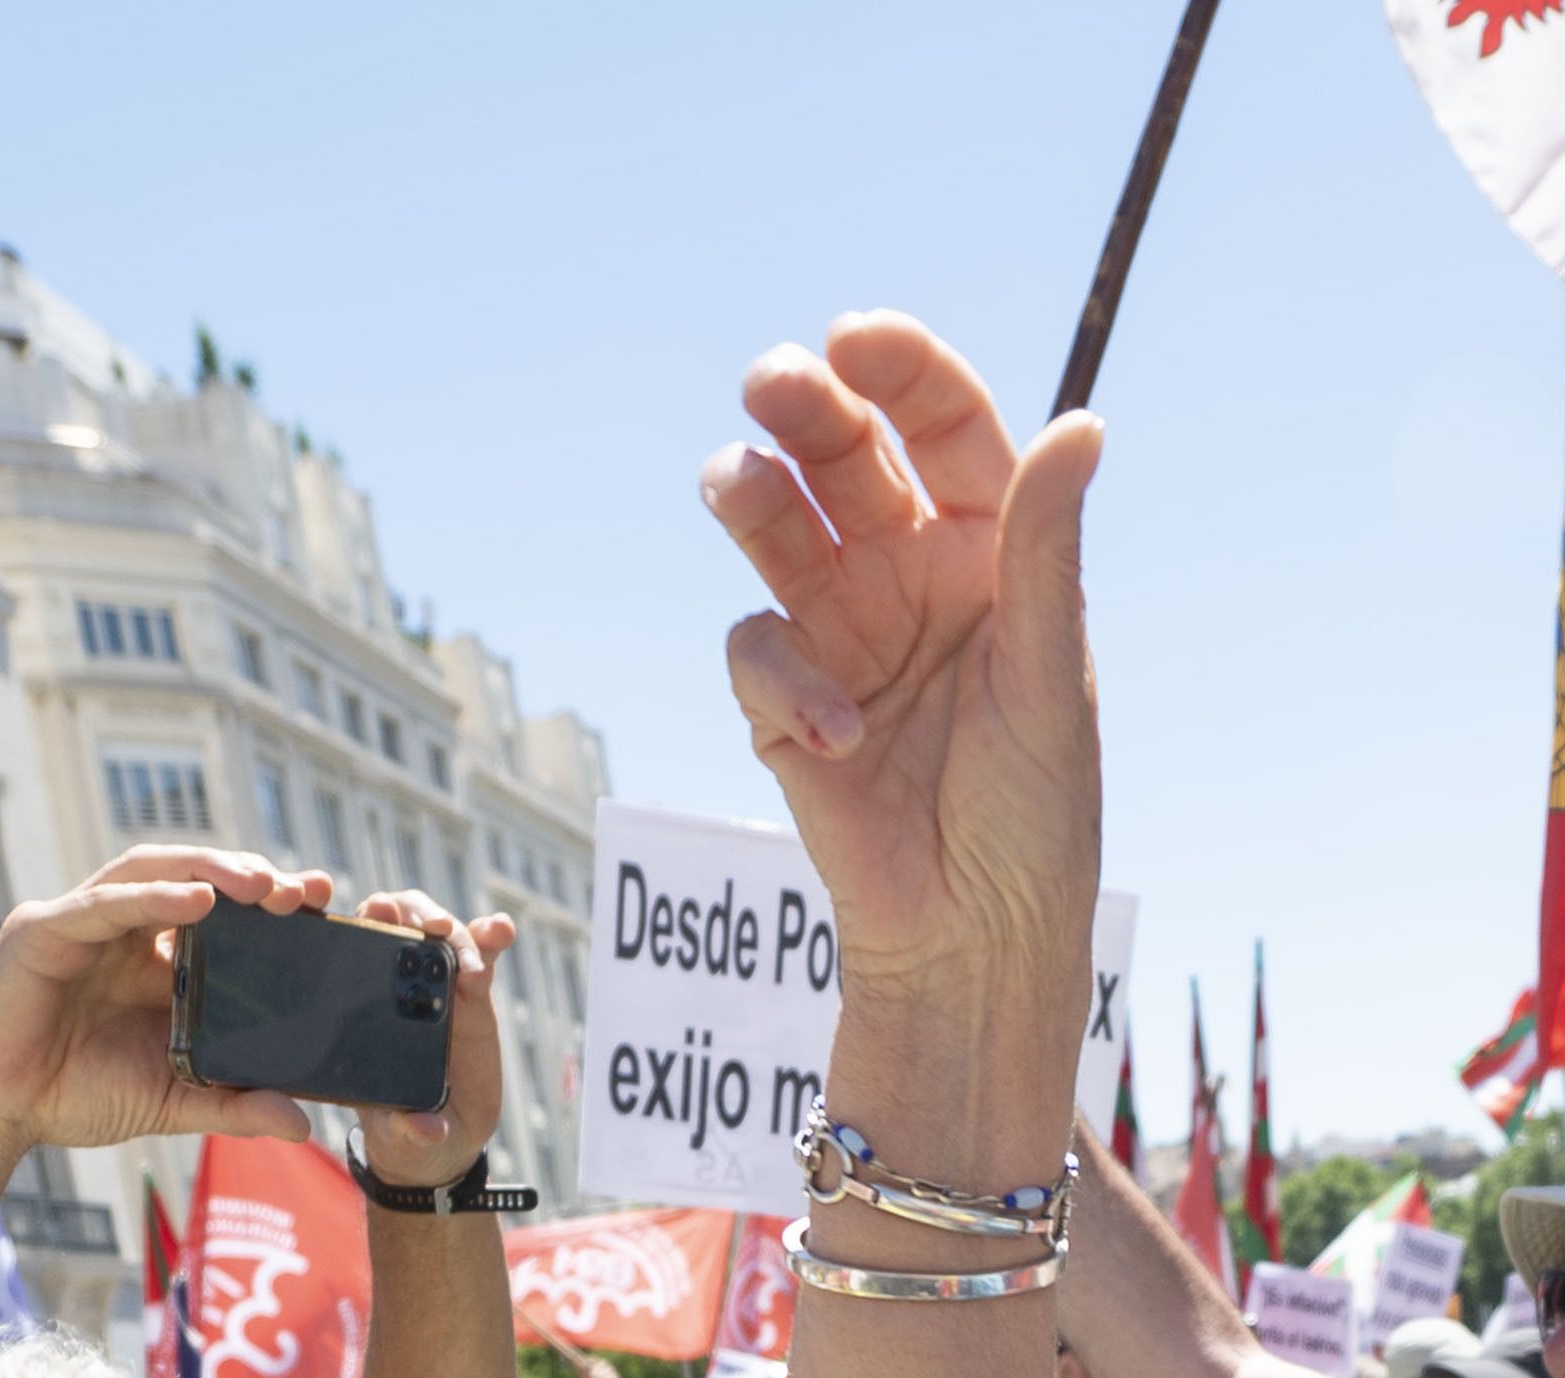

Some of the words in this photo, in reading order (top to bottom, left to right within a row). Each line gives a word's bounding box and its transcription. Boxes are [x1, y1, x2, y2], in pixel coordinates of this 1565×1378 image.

[615, 861, 759, 980] Desde
[775, 888, 841, 993] Po
[608, 1028, 751, 1150] exijo
[770, 1066, 823, 1136] m
